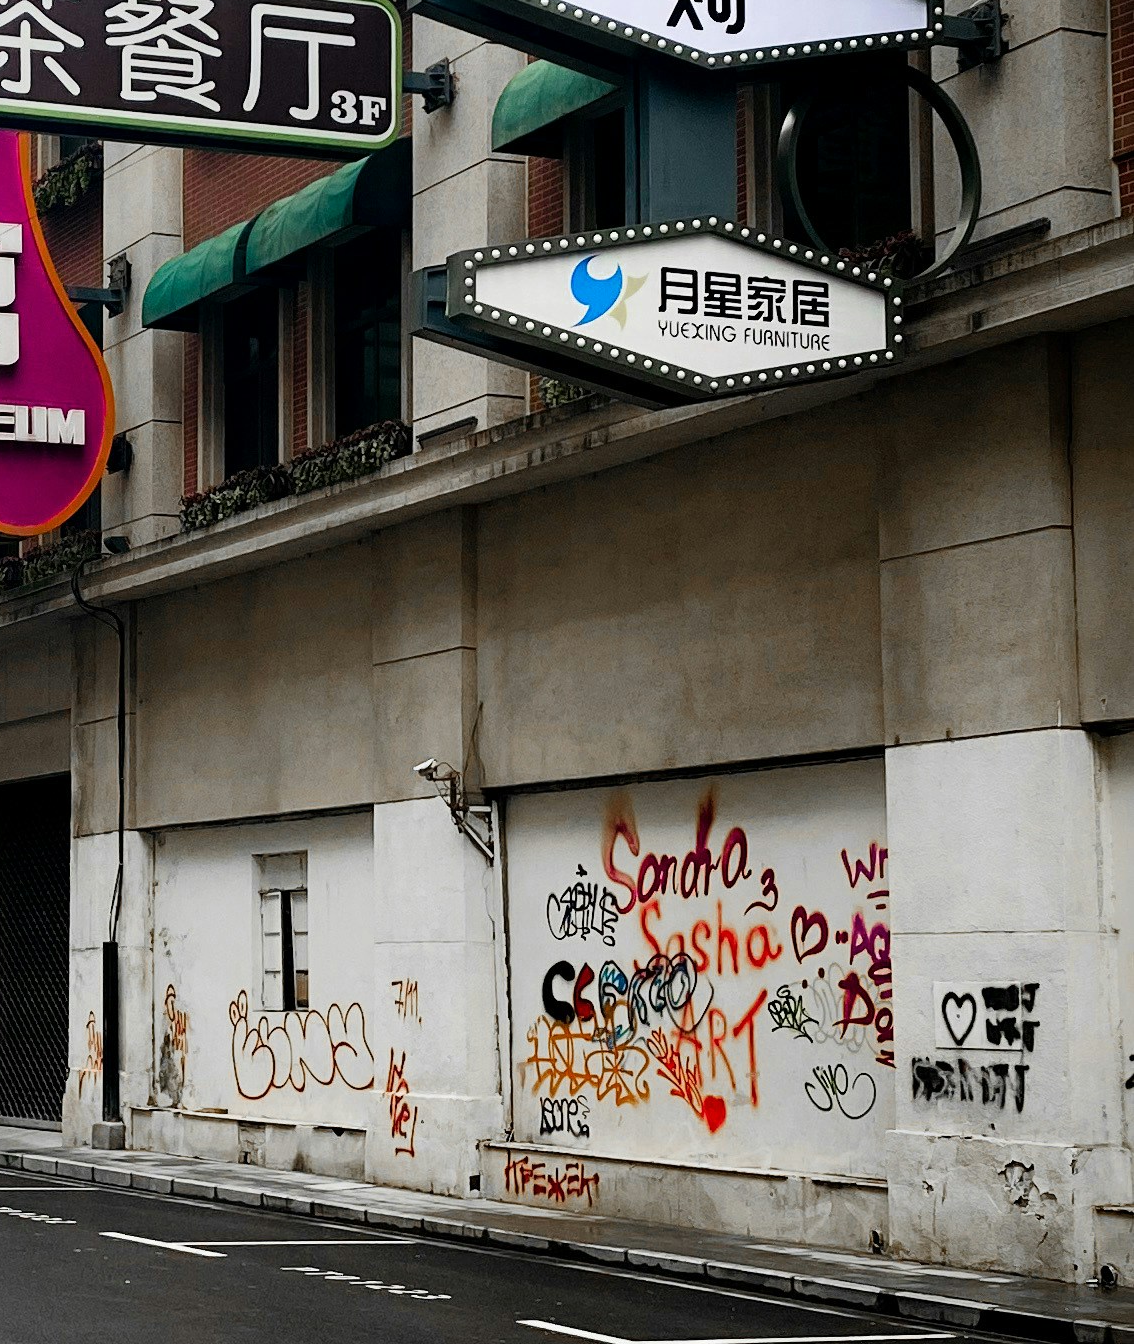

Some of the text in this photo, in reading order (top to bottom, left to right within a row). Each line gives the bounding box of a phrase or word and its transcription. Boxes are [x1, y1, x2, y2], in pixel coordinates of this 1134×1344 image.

[329, 89, 388, 128] 3F
[658, 266, 831, 329] 月星家居
[657, 320, 831, 352] YUEXING FURNITURE
